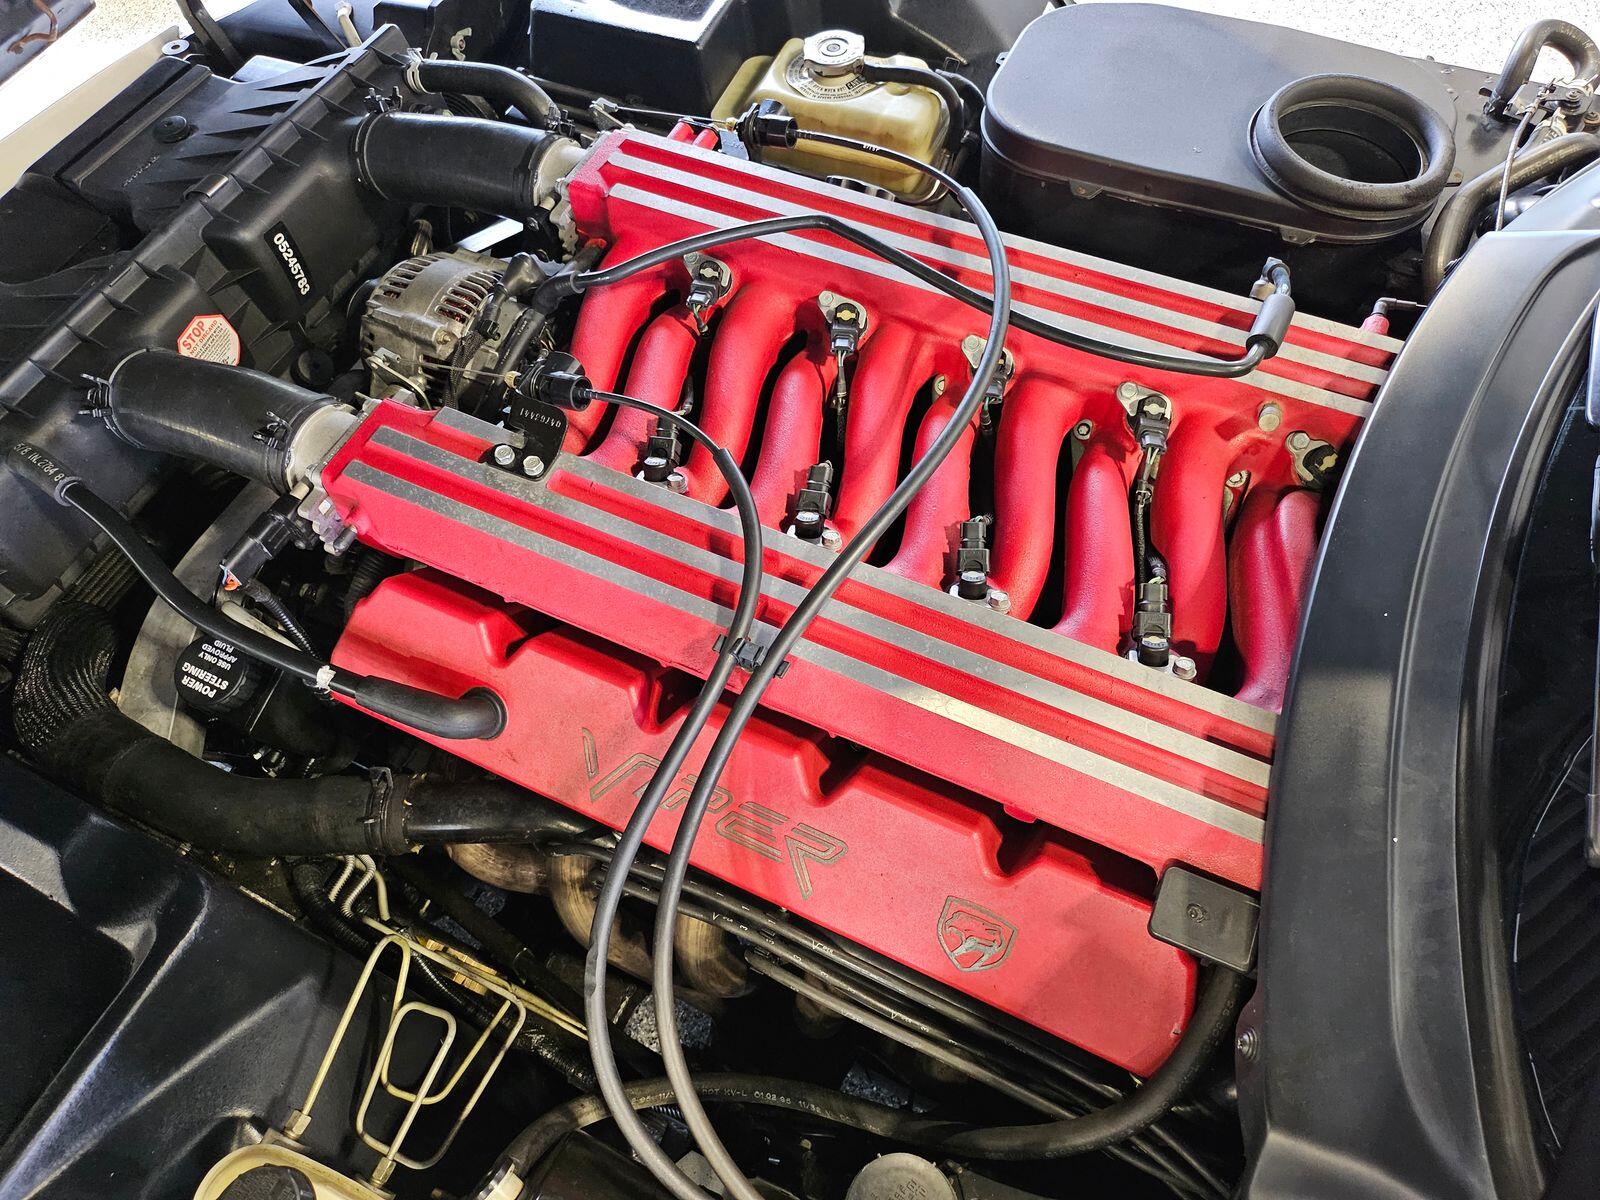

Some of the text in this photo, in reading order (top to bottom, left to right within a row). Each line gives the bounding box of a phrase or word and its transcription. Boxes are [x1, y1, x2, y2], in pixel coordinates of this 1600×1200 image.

[274, 232, 310, 295] 05245783
[181, 320, 204, 351] STOP
[190, 343, 199, 355] NOT
[199, 319, 218, 343] DISCARD
[202, 644, 238, 663] APPROVED
[214, 640, 234, 654] FLUID
[198, 651, 232, 670] USE ONLY
[181, 675, 217, 699] POWER
[182, 662, 229, 690] STEERING
